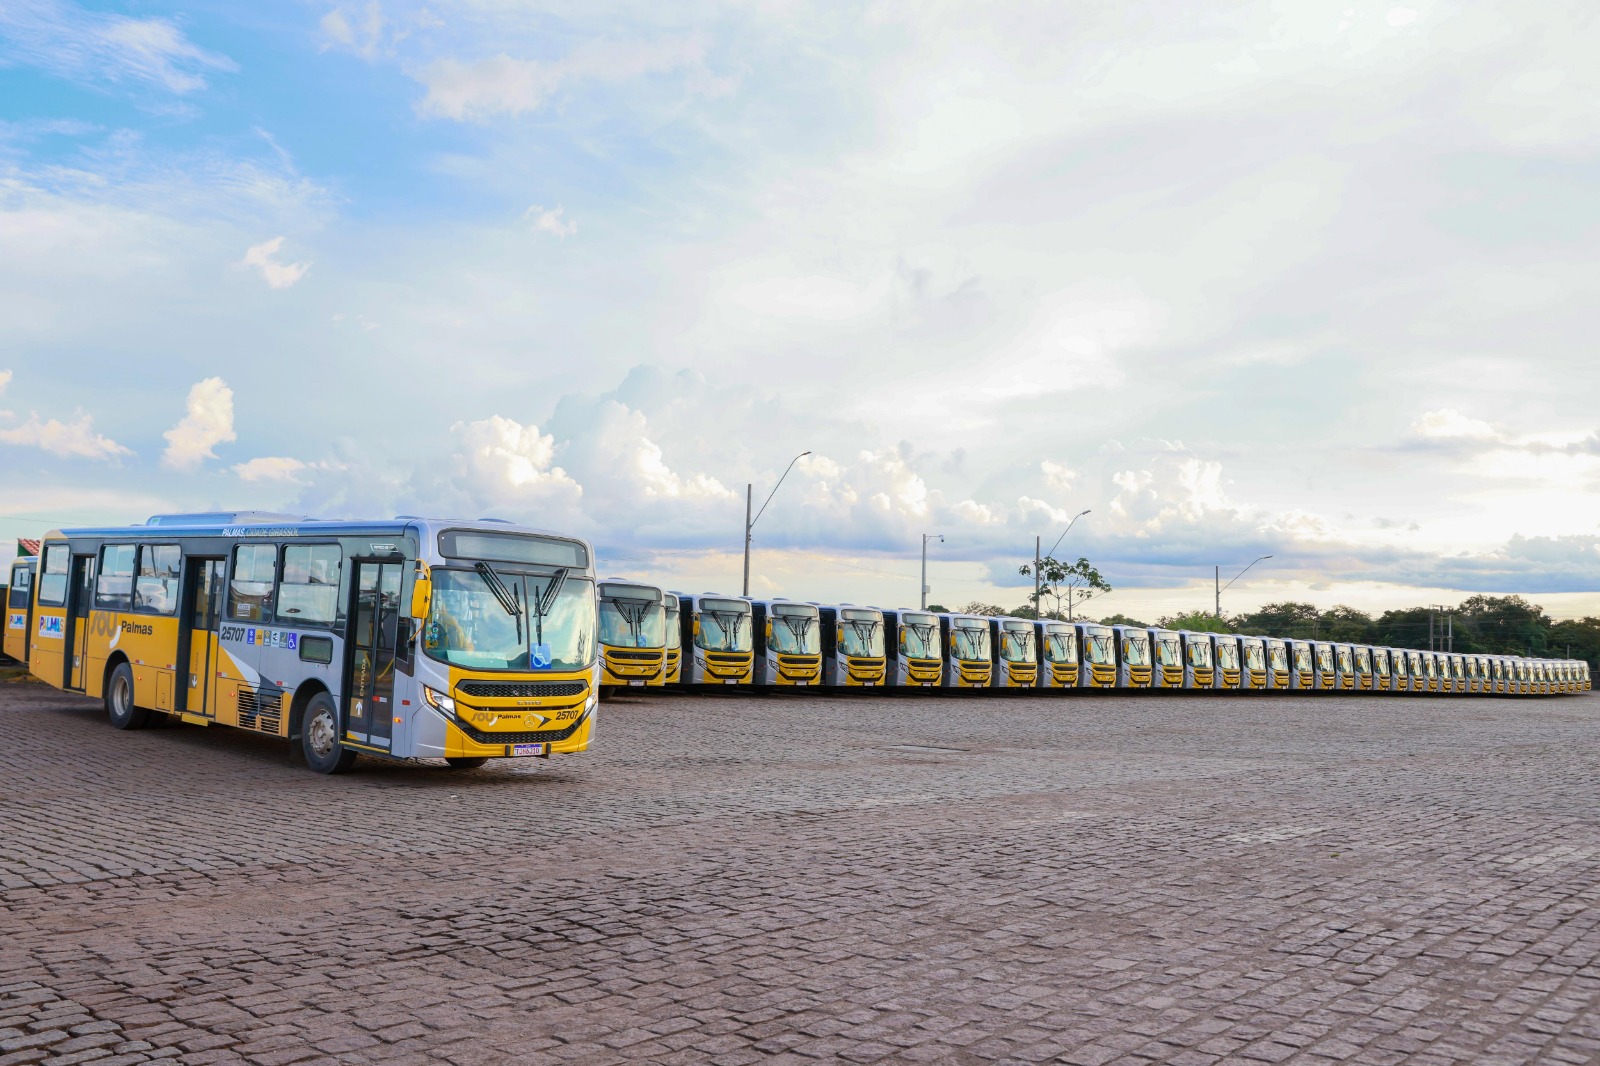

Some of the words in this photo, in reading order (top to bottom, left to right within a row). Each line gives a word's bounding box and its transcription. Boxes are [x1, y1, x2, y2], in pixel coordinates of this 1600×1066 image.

[40, 616, 65, 632] PALMAS
[121, 620, 153, 636] Palmas
[221, 626, 246, 642] 25707
[555, 710, 579, 720] 25707
